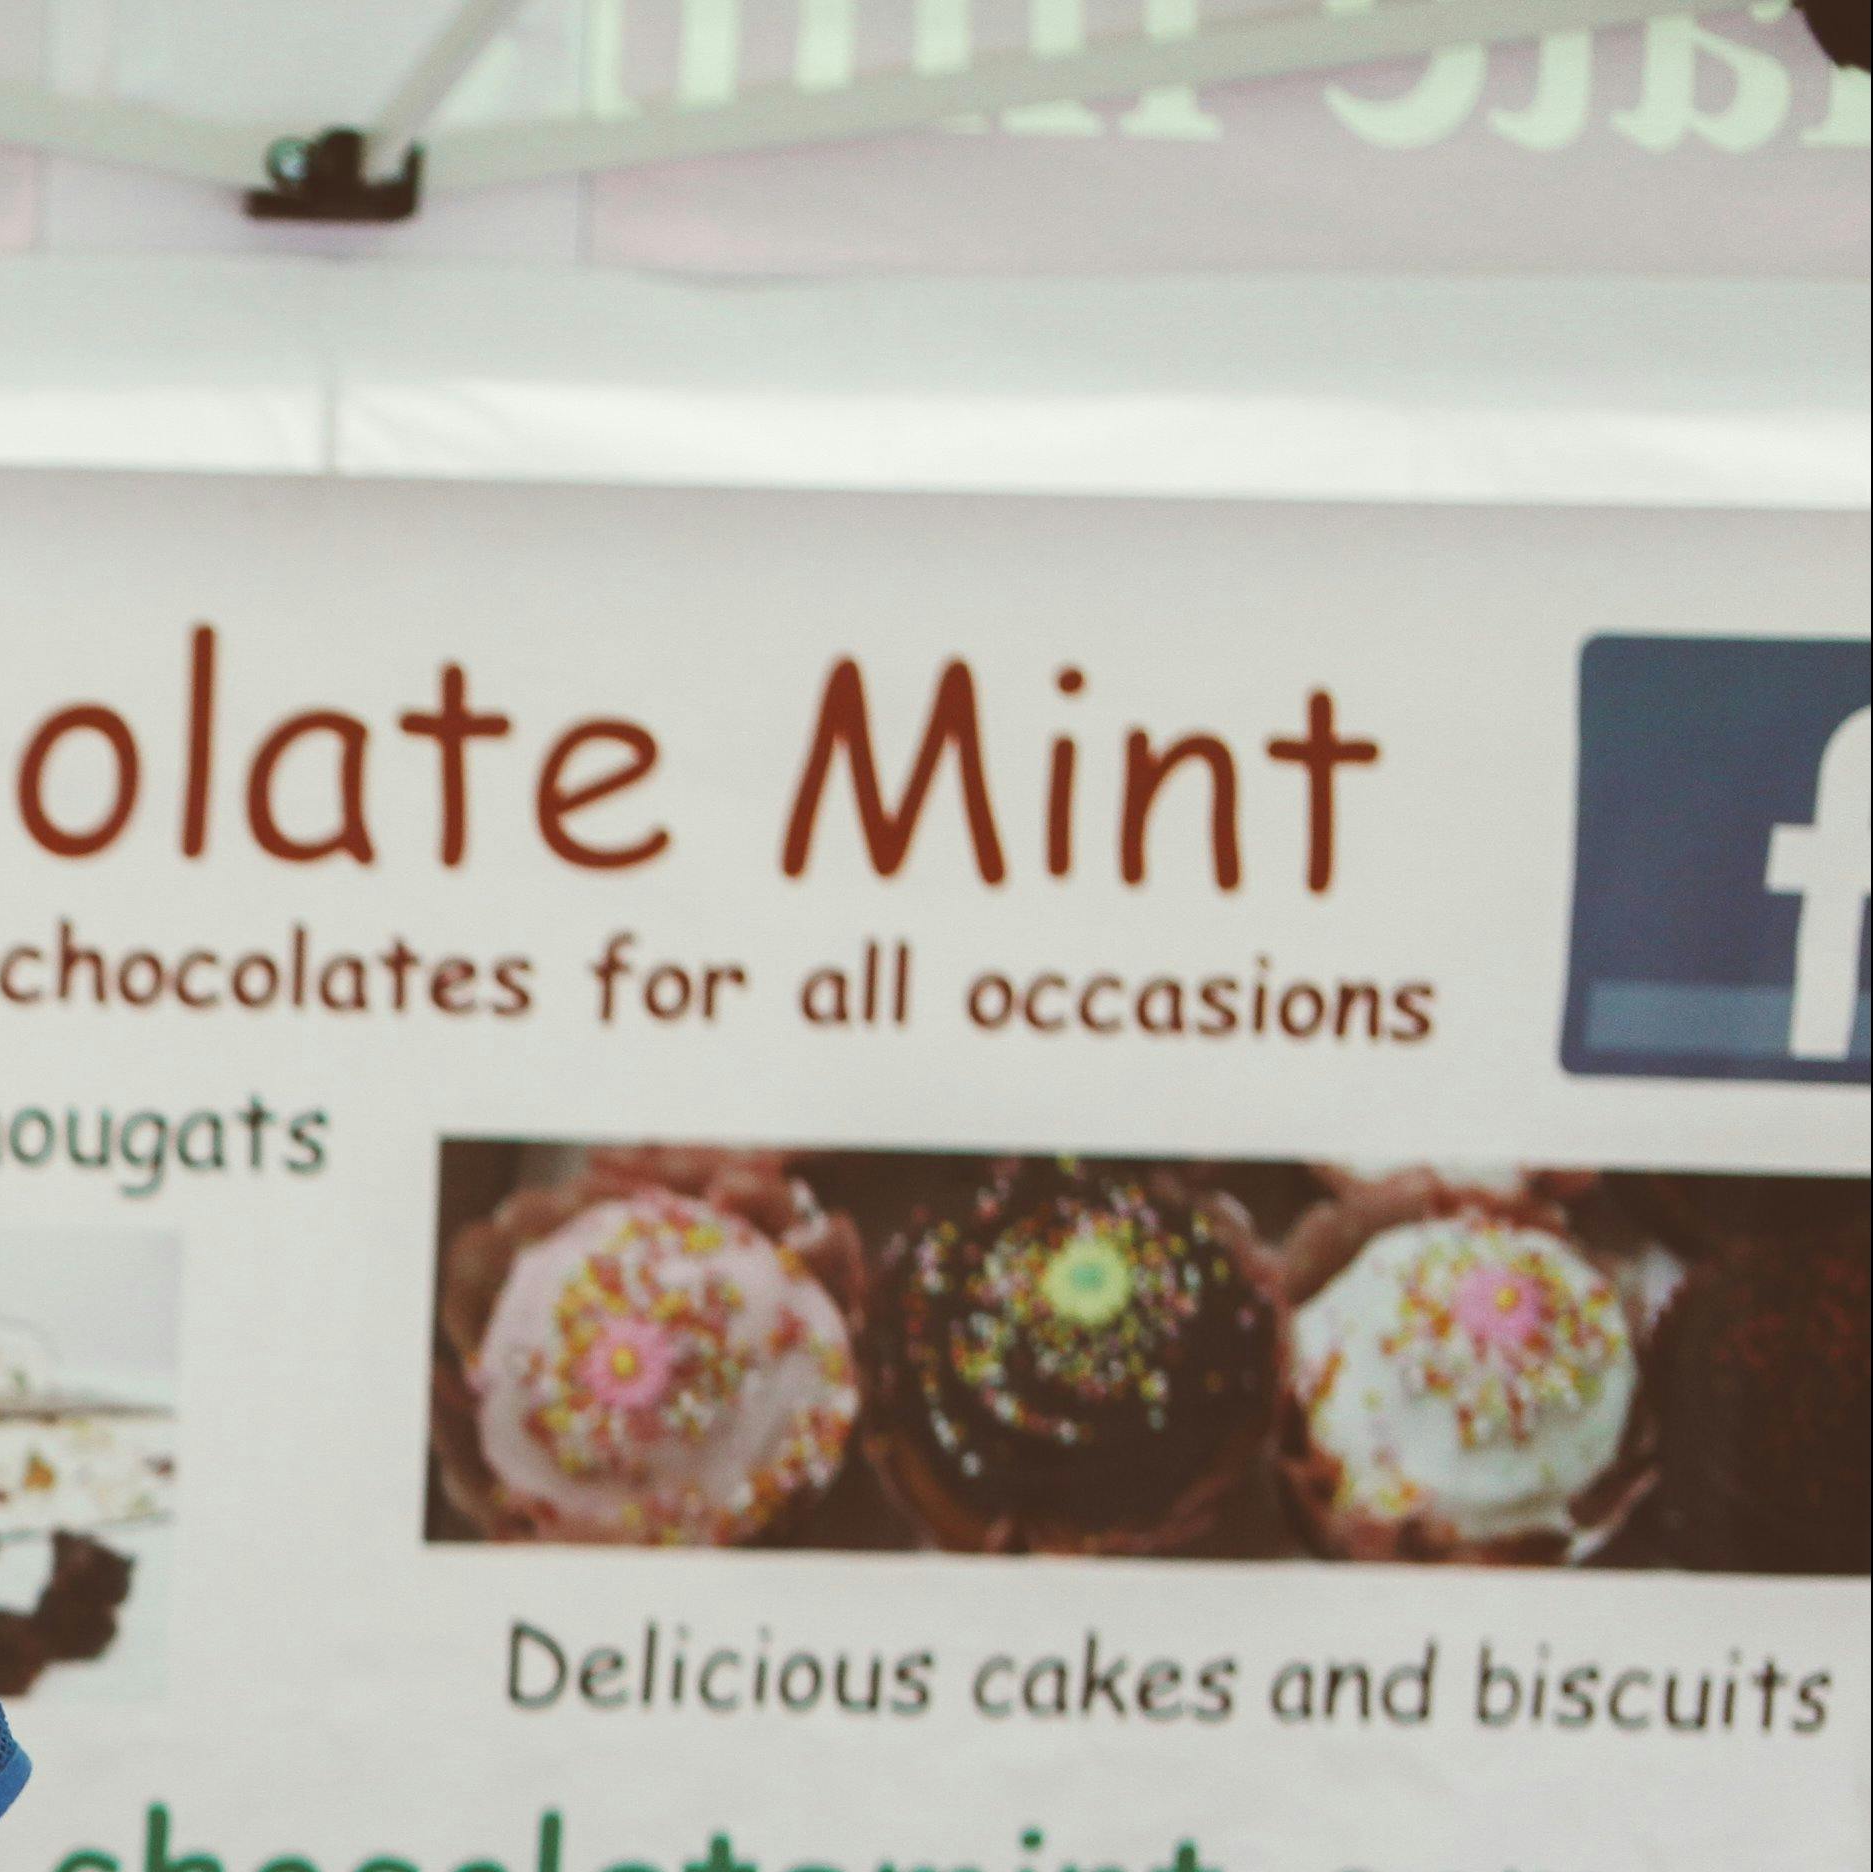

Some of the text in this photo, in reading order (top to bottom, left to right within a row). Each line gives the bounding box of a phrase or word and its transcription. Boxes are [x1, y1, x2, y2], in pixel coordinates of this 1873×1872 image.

[779, 655, 1380, 893] Mint
[592, 931, 748, 1025] for
[800, 940, 912, 1028] all
[967, 957, 1438, 1044] occasions
[505, 1621, 1834, 1737] Delicious cakes and biscuits
